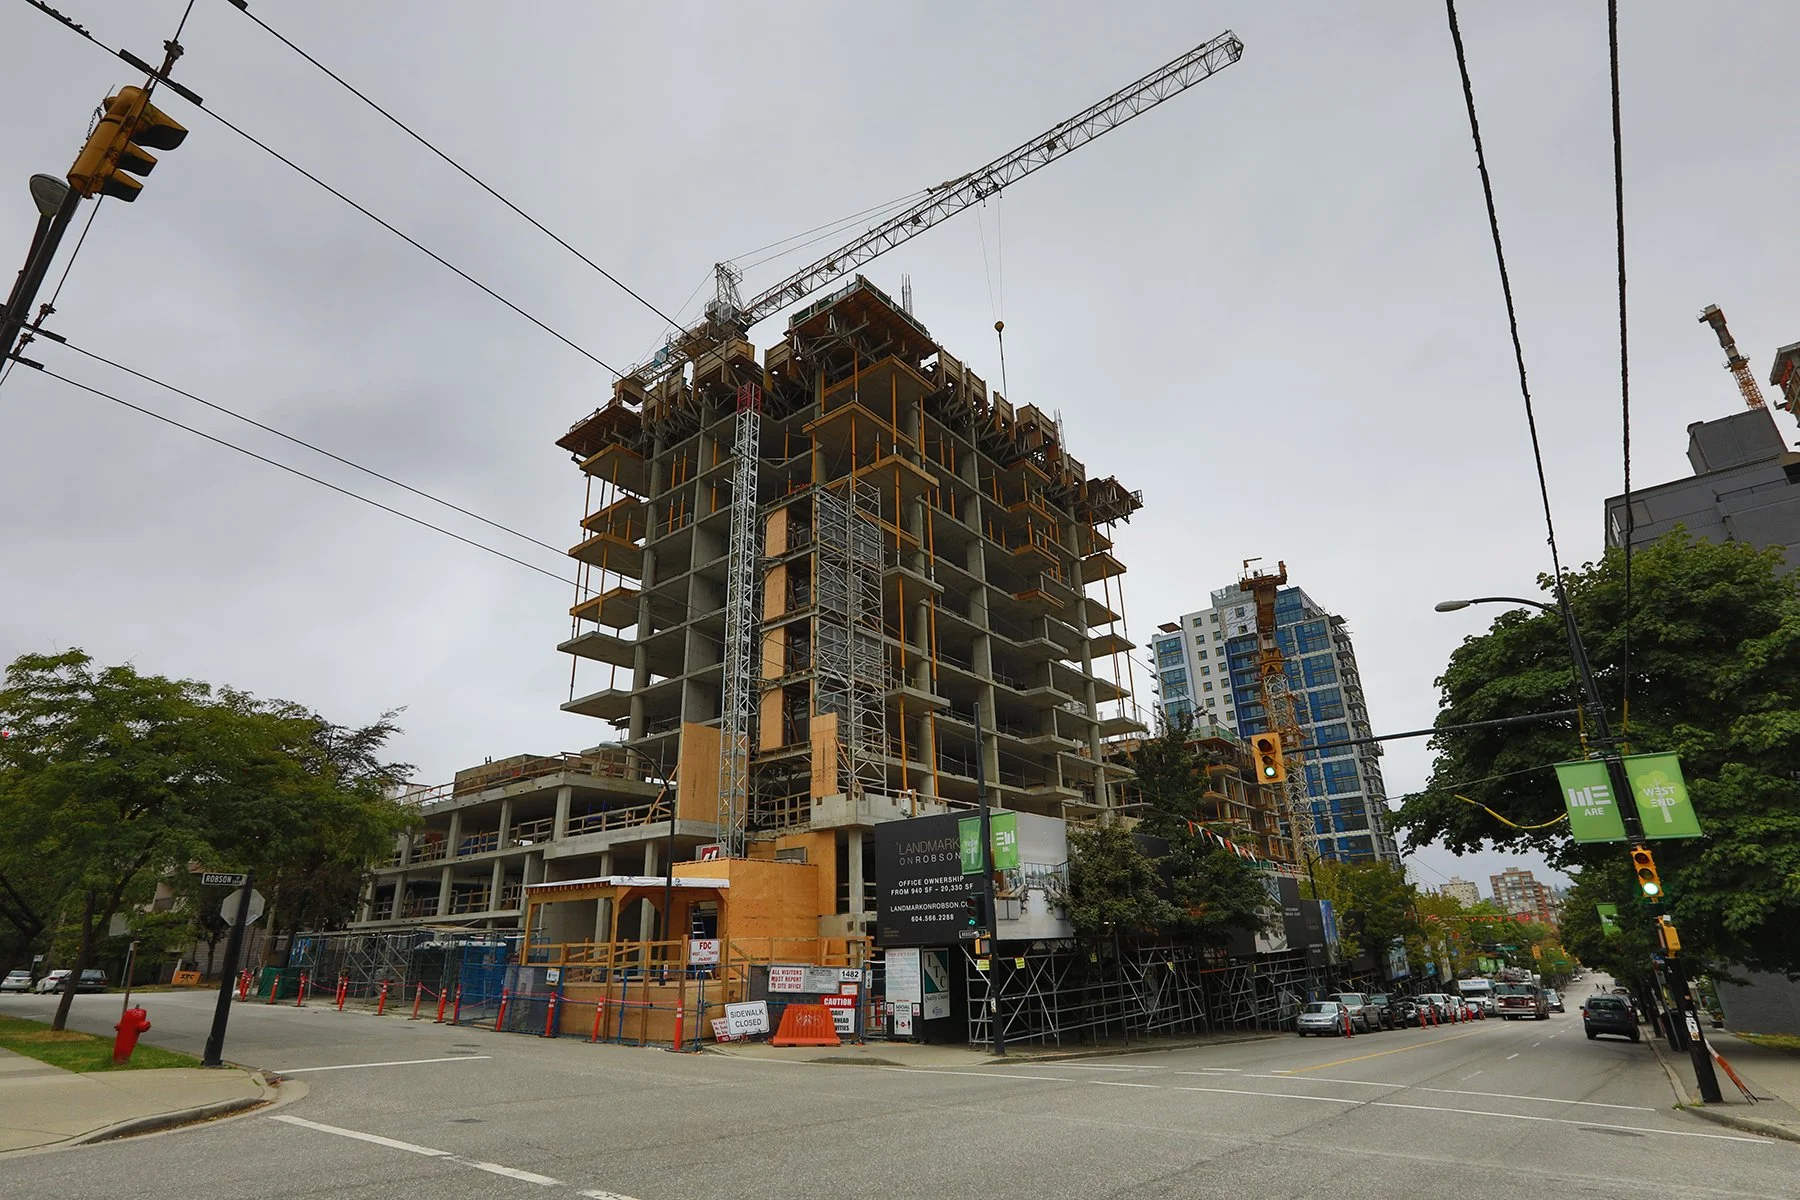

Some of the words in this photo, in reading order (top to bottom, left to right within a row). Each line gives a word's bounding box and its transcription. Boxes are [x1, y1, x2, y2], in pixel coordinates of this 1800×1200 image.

[1568, 785, 1612, 807] WE
[1643, 786, 1675, 796] WEST
[1650, 798, 1675, 807] END
[1584, 807, 1605, 816] ARE
[898, 837, 960, 855] LANDMARK
[205, 875, 233, 883] ROBSON
[898, 879, 922, 887] OFFICE
[924, 875, 964, 885] OWNERSHIP
[699, 941, 712, 950] FDC
[730, 1008, 765, 1018] SIDEWALK
[735, 1018, 762, 1028] CLOSED
